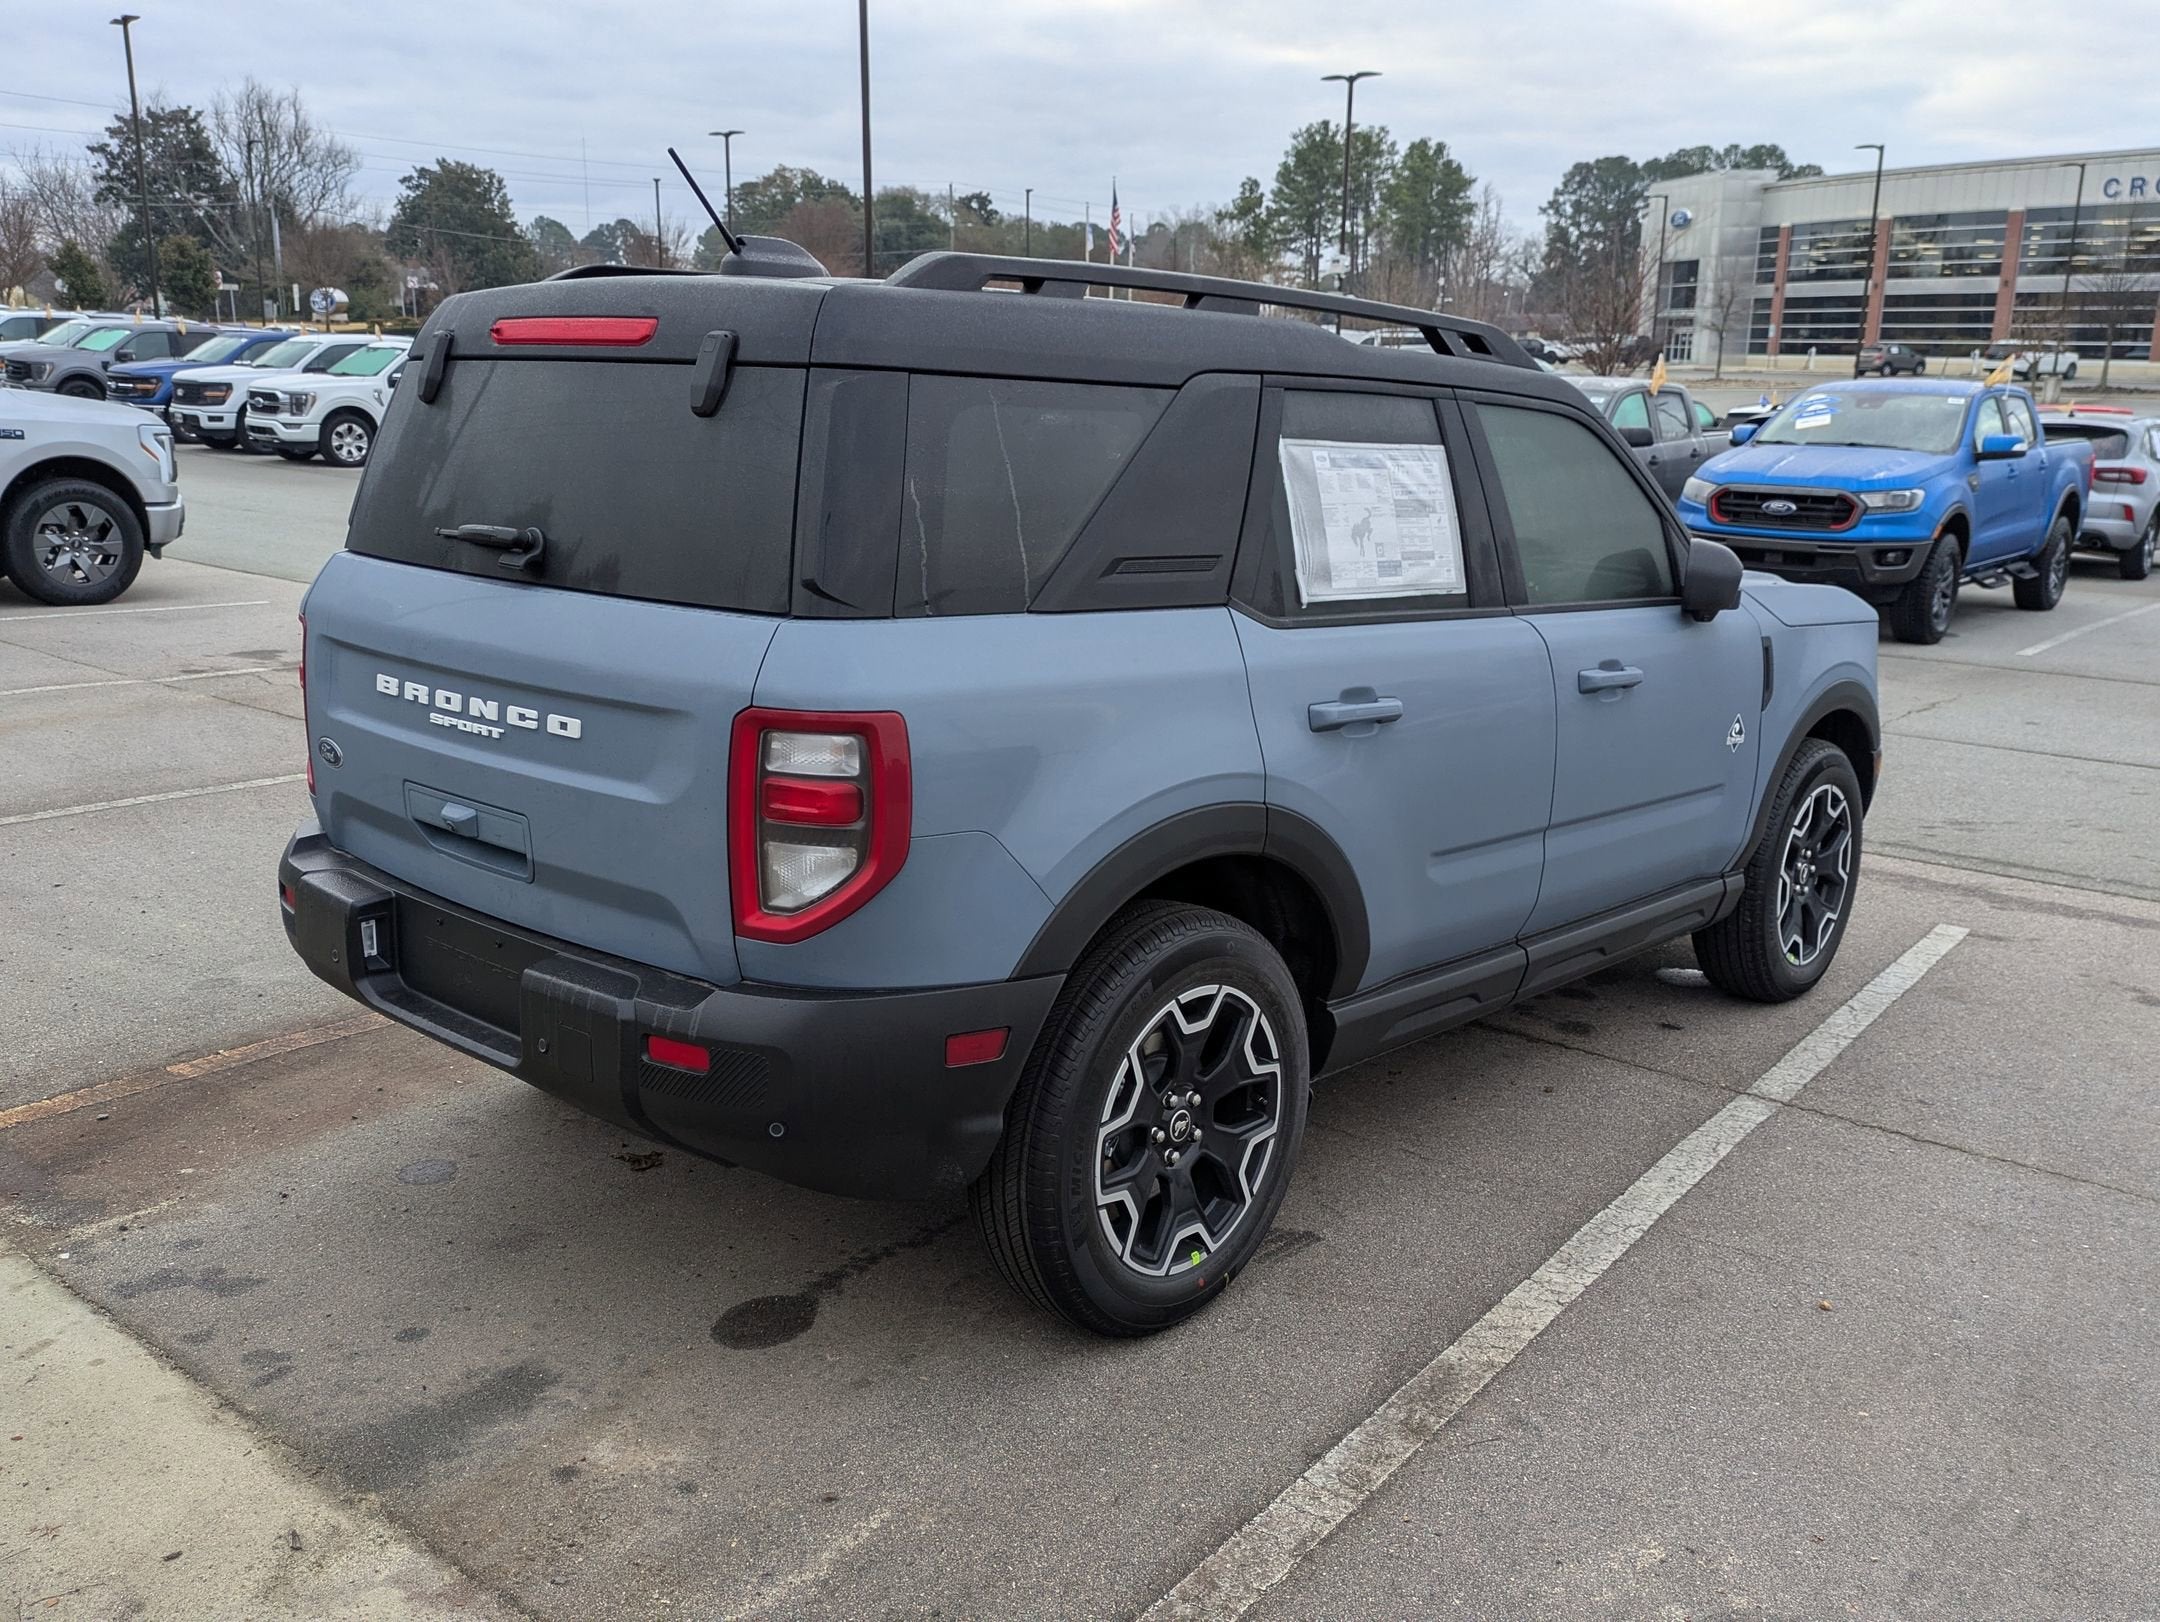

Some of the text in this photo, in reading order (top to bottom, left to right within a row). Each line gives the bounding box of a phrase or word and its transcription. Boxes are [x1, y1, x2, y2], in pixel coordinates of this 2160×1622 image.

[2103, 177, 2160, 198] CR
[376, 673, 582, 739] BRONCO
[429, 712, 505, 739] SPORT
